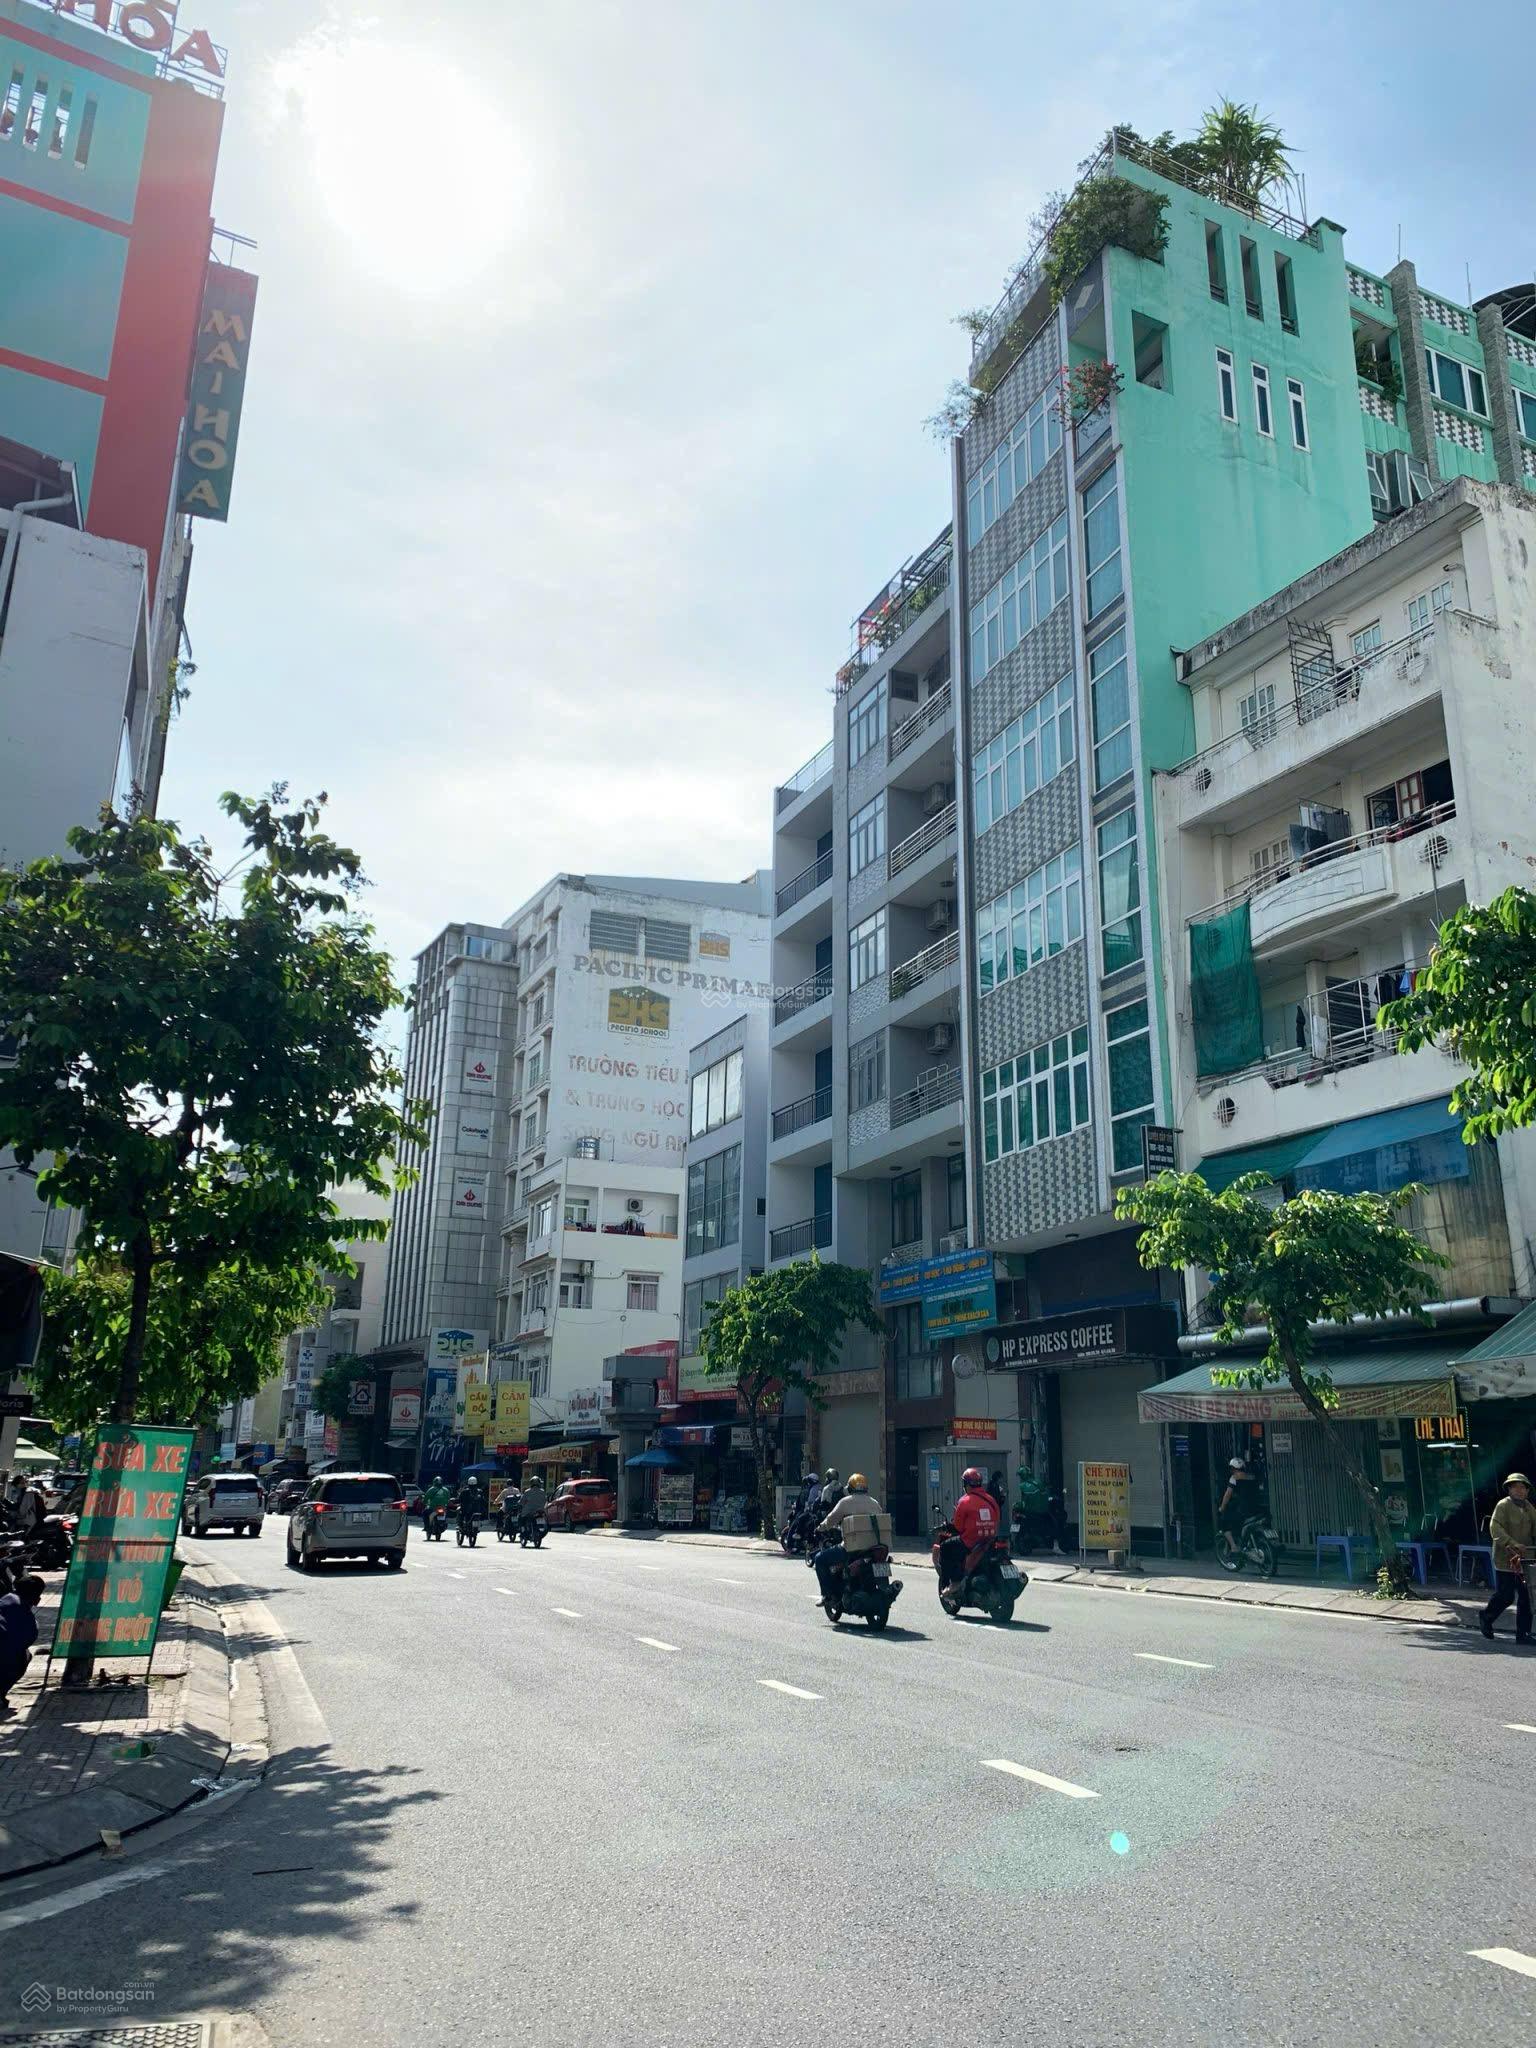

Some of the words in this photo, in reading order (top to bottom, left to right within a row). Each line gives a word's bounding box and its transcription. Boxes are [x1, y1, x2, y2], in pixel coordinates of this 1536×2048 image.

[203, 309, 247, 395] MAI
[186, 403, 231, 509] HOA
[573, 954, 673, 985] PACIFIC
[610, 1023, 638, 1033] PACIFIC
[640, 1026, 667, 1038] SCHOOL
[587, 1092, 646, 1113] TRUNG
[1002, 1339, 1016, 1359] HP
[1019, 1330, 1068, 1356] EXPRESS
[1070, 1323, 1114, 1349] COFFEE
[93, 1432, 146, 1472] SỬA
[151, 1445, 188, 1473] XE
[83, 1481, 137, 1519] RỬA
[143, 1492, 179, 1520] XE
